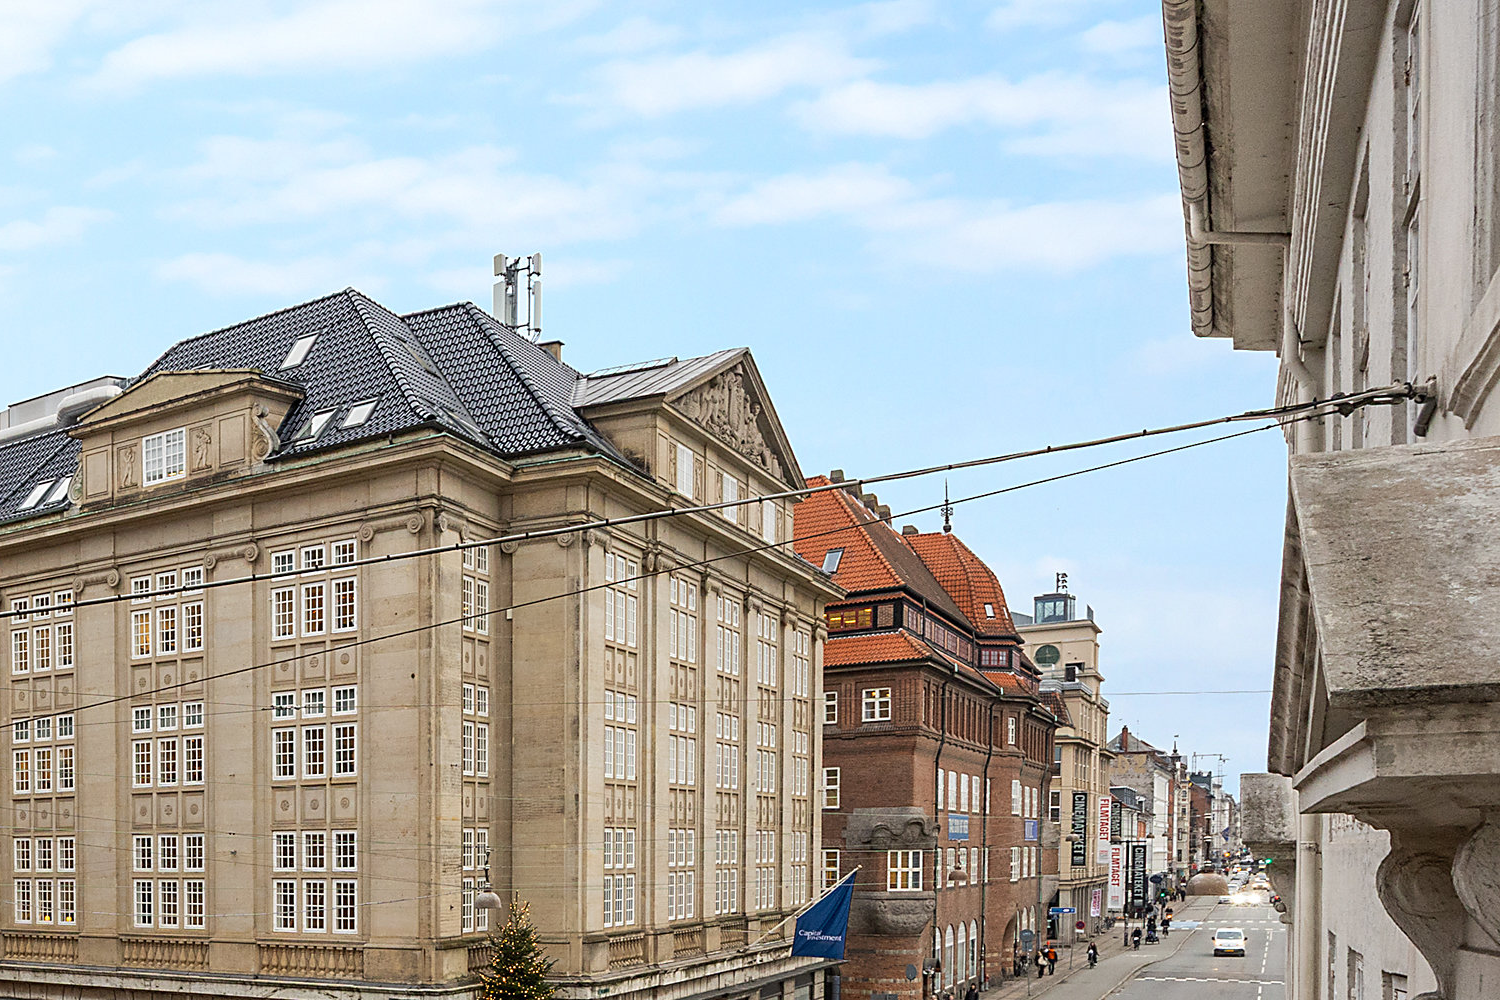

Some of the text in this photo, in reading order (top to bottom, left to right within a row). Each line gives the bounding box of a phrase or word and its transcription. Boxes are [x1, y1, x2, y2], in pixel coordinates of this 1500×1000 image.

[1100, 798, 1109, 841] FILMTAGET
[1111, 802, 1120, 837] CINEMAT
[1111, 847, 1120, 887] FILMTAGET
[1134, 847, 1144, 897] CINEMATEKET
[798, 929, 823, 937] Capital
